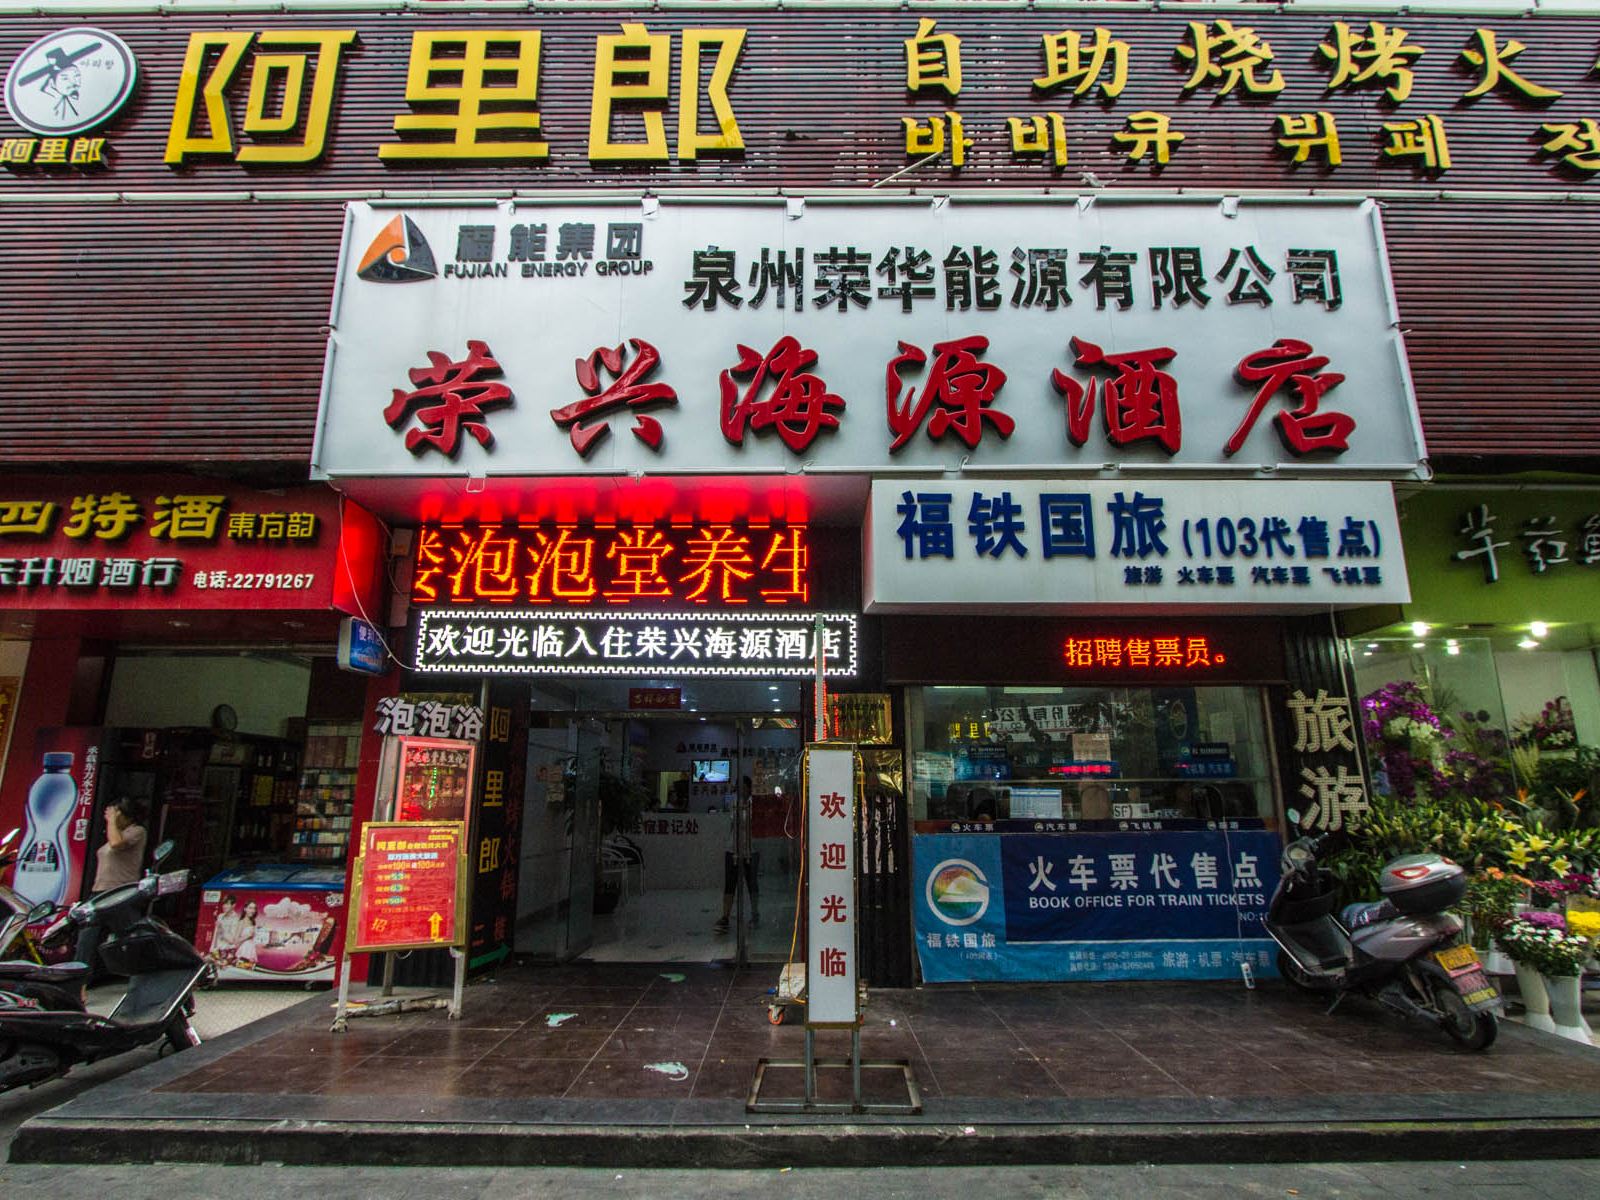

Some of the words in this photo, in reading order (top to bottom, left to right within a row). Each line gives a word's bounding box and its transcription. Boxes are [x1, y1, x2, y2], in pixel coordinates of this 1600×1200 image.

[904, 17, 1600, 102] 自助烧烤火
[164, 23, 748, 165] 阿里郎
[0, 136, 106, 164] 阿里郎
[902, 110, 1186, 167] 바비큐
[1275, 110, 1452, 170] 뷔페
[454, 221, 644, 262] 福能集团
[443, 263, 509, 280] FUJIAN
[520, 261, 589, 279] ENERGY
[595, 259, 654, 277] GROUP
[681, 244, 1342, 313] 泉州荣华能源有限公司
[382, 335, 1357, 459] 荣兴海源酒店
[0, 491, 226, 541] 四特酒
[896, 490, 1170, 562] 福铁国旅
[1182, 516, 1382, 559] (103代售点)
[193, 570, 315, 590] 电话:22791267
[1123, 565, 1164, 586] 旅游
[1176, 565, 1236, 587] 火车票
[1251, 565, 1311, 587] 汽车票
[1321, 565, 1383, 587] 飞机票
[426, 625, 842, 662] 欢迎光临入住荣兴海源酒店
[374, 697, 485, 741] 泡泡浴
[1286, 687, 1375, 833] 旅游
[478, 705, 511, 875] 阿里郎
[962, 822, 995, 833] 火车票
[818, 790, 848, 979] 欢迎光临
[1028, 850, 1263, 892] 火车票代售点
[1029, 895, 1072, 910] BOOK
[1074, 895, 1125, 909] OFFICE
[1127, 894, 1157, 907] FOR
[1158, 893, 1203, 907] TRAIN
[1206, 892, 1266, 906] TICKETS
[926, 931, 997, 949] 福铁国旅
